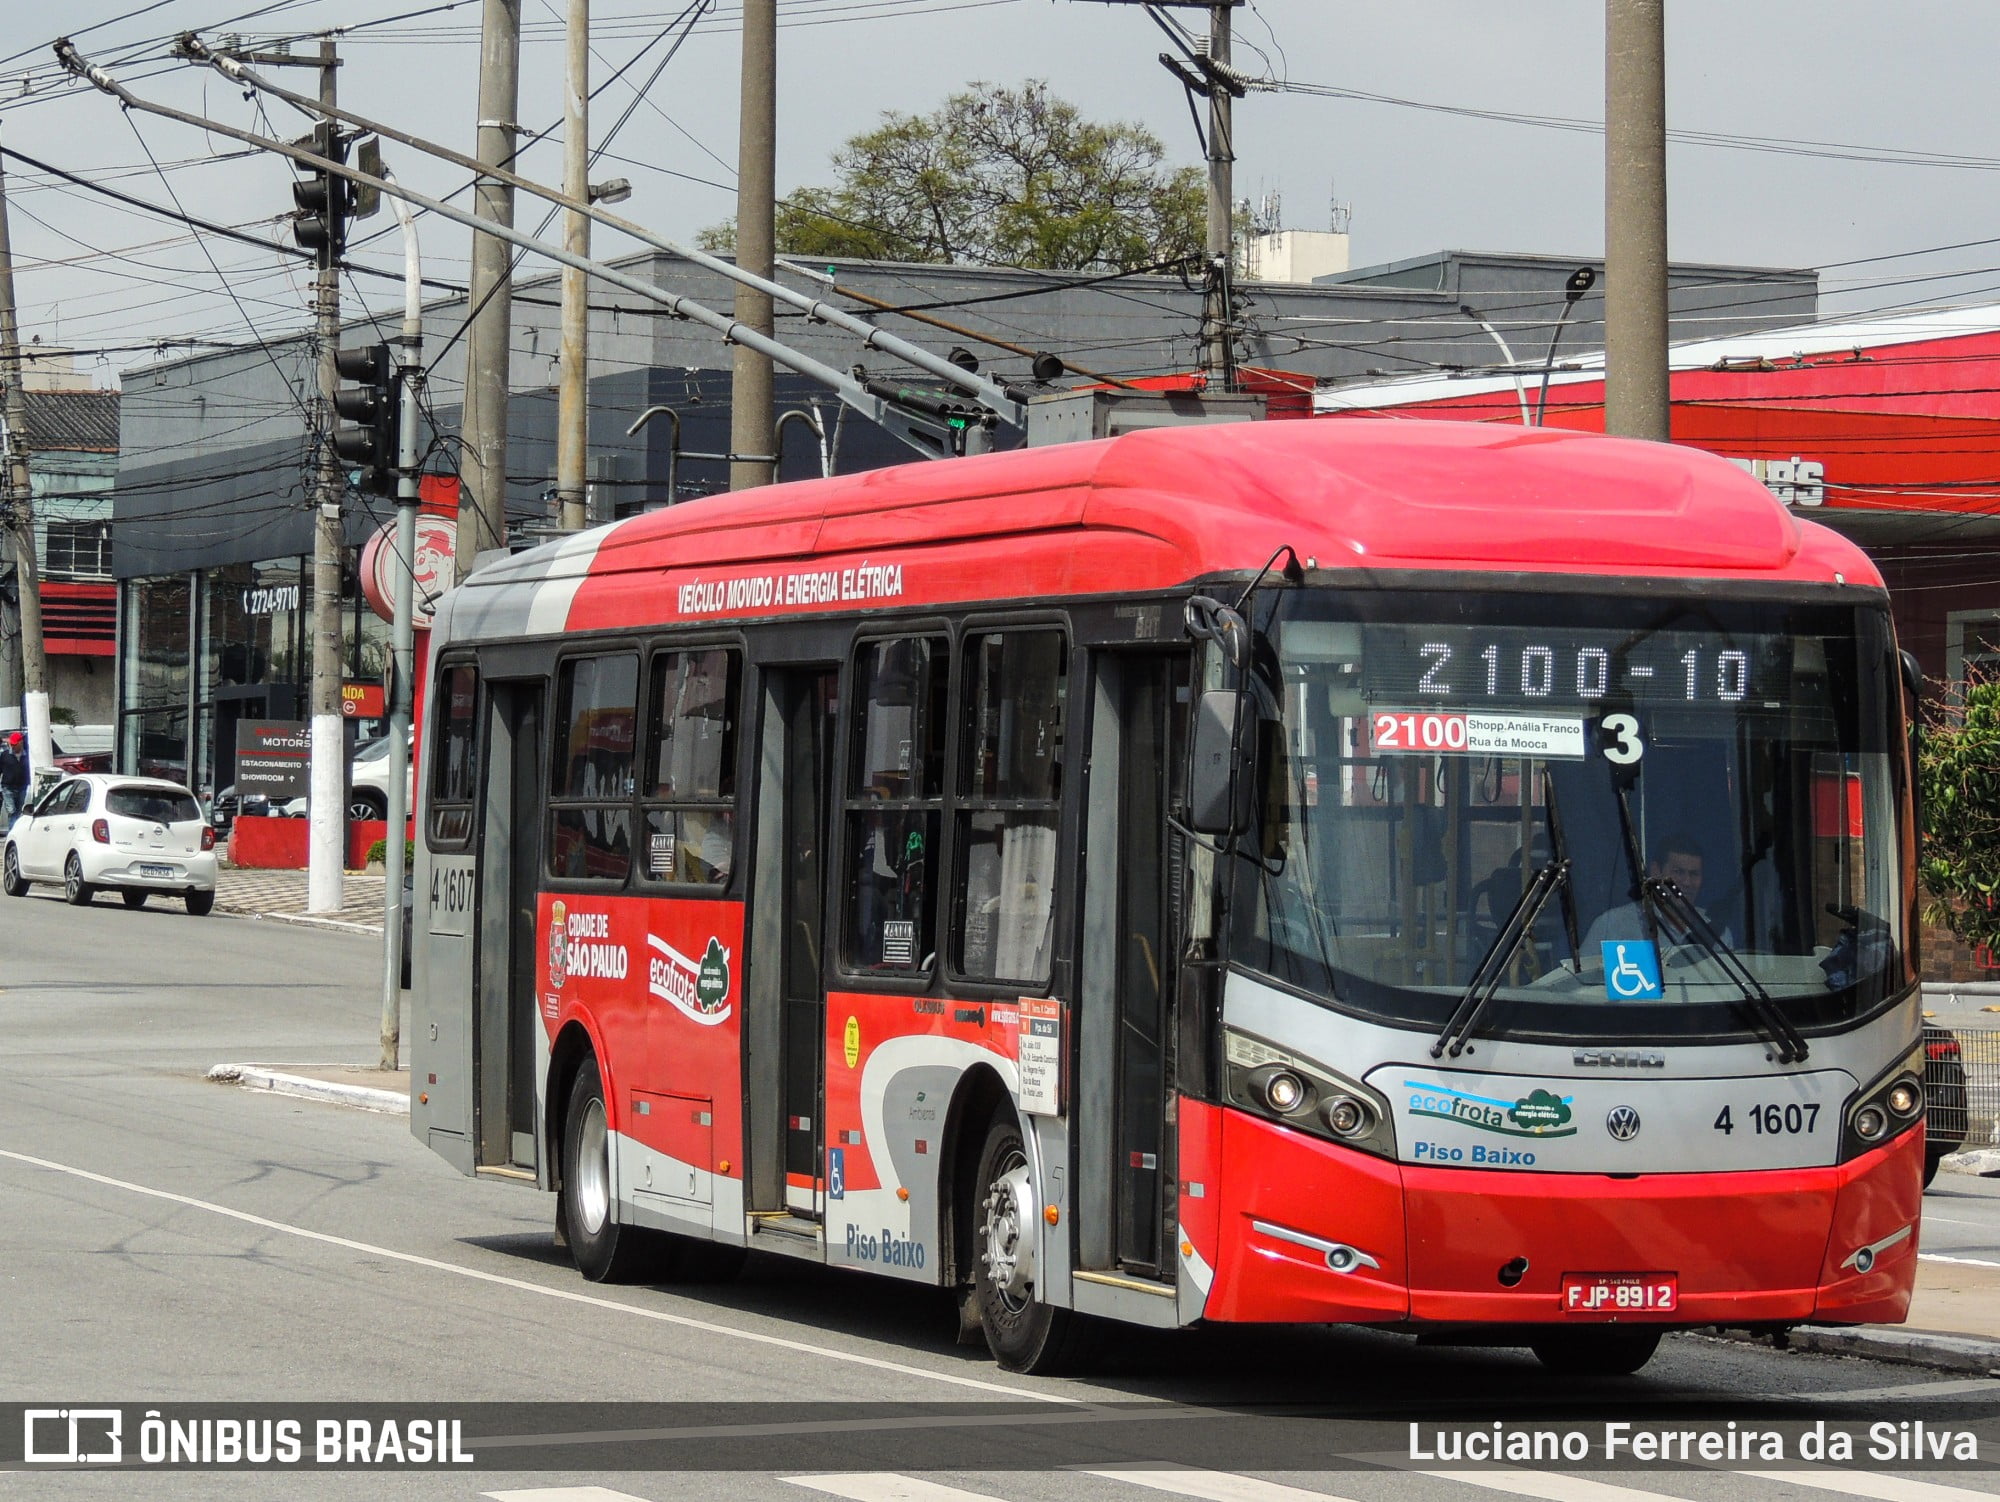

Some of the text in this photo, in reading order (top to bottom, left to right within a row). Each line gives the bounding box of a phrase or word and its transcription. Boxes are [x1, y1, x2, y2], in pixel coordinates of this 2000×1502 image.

[251, 586, 299, 614] 2724-9710
[678, 561, 902, 613] VEÍCULO MOVIDO A ENERGIA ELÉTRICA
[342, 684, 365, 700] AÍDA
[263, 738, 311, 748] MOTORS
[1377, 716, 1466, 748] 2100
[1543, 722, 1580, 733] Franco
[1469, 737, 1548, 749] Rua da Mooca
[1601, 713, 1643, 764] 3
[241, 760, 302, 769] ESTACIONAMENTO
[241, 773, 284, 782] SHOWROOM
[432, 868, 474, 912] 4 1607
[568, 914, 609, 938] CIDADE DE
[566, 938, 627, 979] SÃO PAULO
[650, 957, 695, 1008] ecofrota
[1573, 1050, 1665, 1067] CAIO
[1409, 1094, 1502, 1127] ecofrota
[1515, 1110, 1559, 1119] energia elétrica
[1714, 1103, 1821, 1135] 4 1607
[1414, 1141, 1536, 1166] Piso Baixo
[846, 1223, 925, 1270] Piso Baixo
